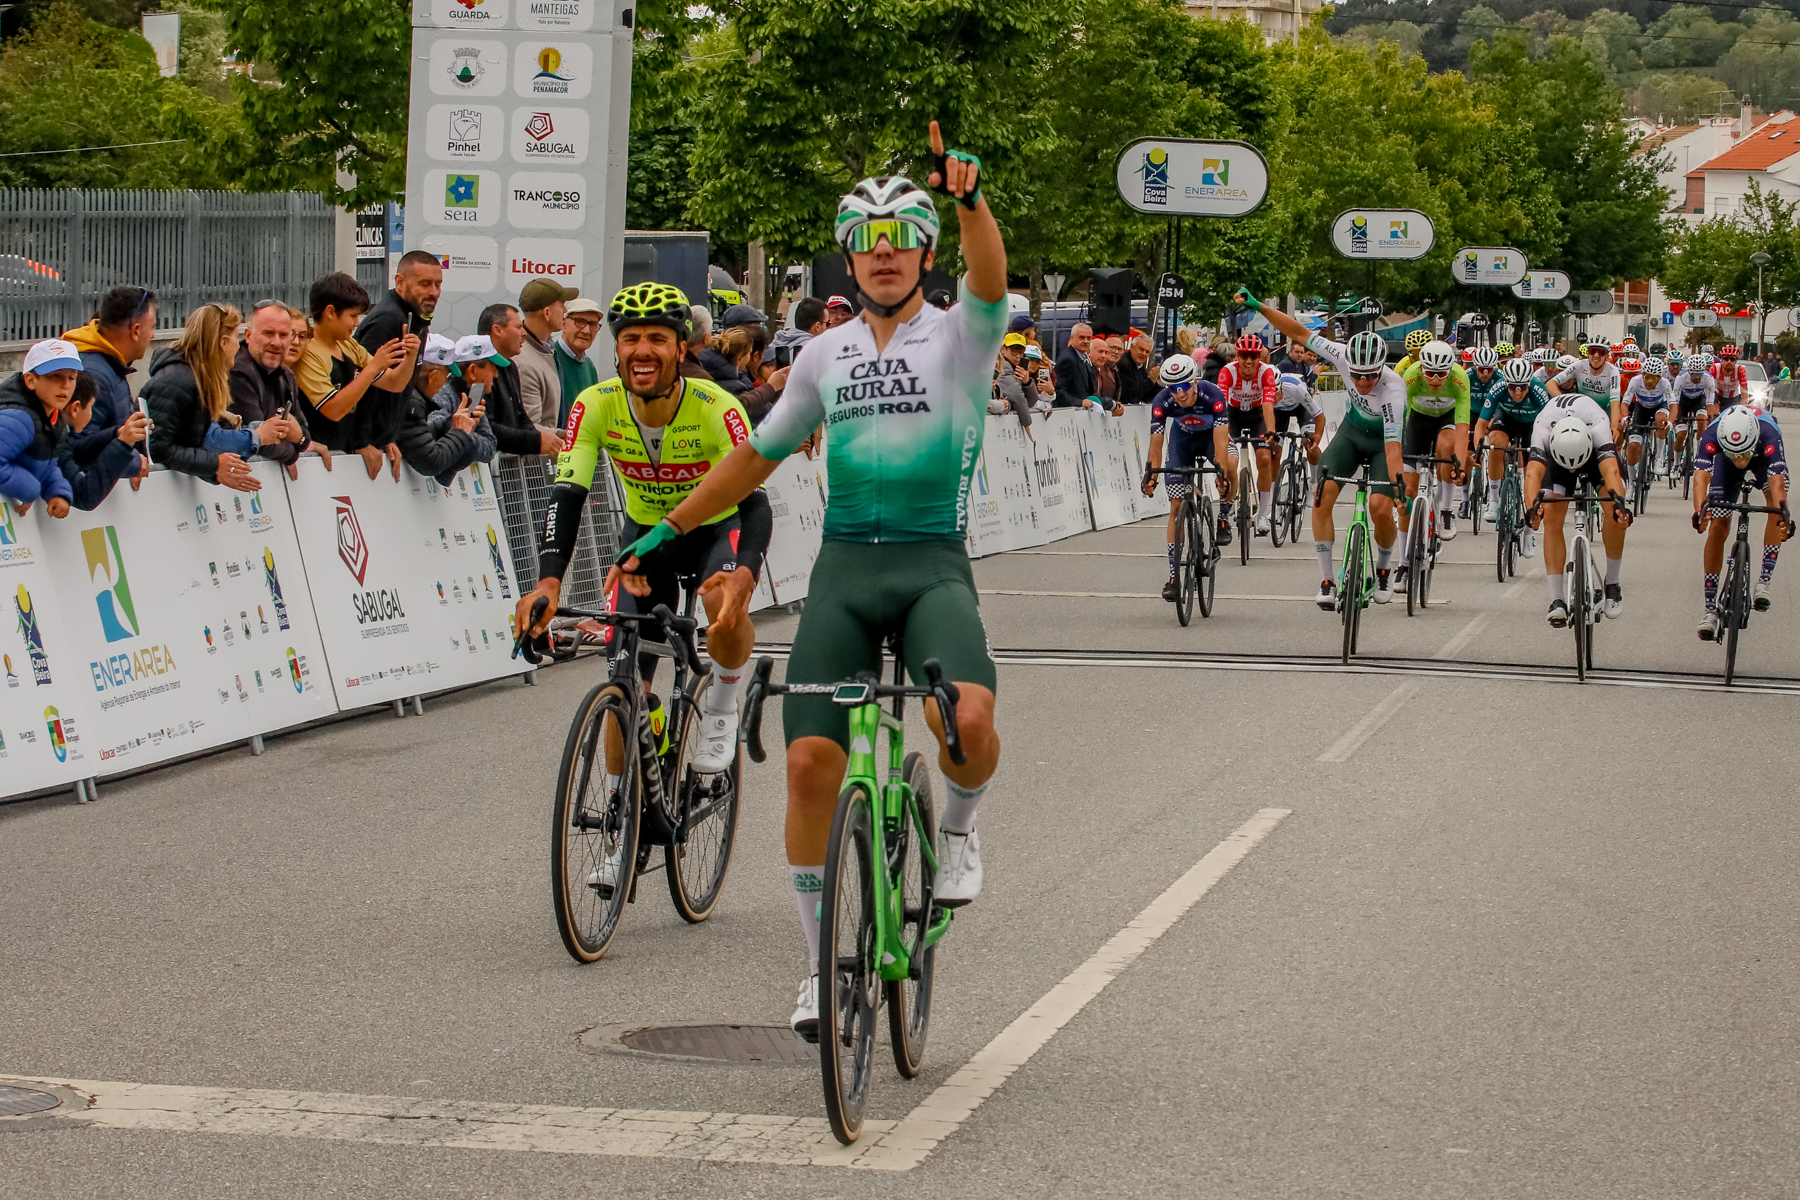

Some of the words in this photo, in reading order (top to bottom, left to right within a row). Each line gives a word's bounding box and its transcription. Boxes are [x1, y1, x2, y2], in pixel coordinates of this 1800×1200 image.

[449, 10, 490, 20] GUARDA
[531, 3, 579, 16] MANTEIGAS
[533, 86, 569, 94] PENAMACOR
[448, 142, 481, 152] Pinhel
[525, 142, 576, 154] SABUGAL
[514, 189, 581, 203] TRANCOSO
[1145, 188, 1166, 196] Cova
[1185, 186, 1248, 197] ENERAREA
[542, 202, 580, 210] MUNICÍPIO
[1144, 195, 1166, 203] Beira
[444, 209, 478, 222] seia
[512, 258, 576, 275] Litocar
[850, 358, 912, 380] CAJA
[835, 377, 927, 405] RURAL
[829, 404, 875, 425] SEGUROS
[878, 401, 931, 414] RGA
[562, 407, 583, 450] SABGAL
[726, 410, 747, 443] SABG
[672, 439, 701, 450] LOVE
[961, 425, 977, 471] CAJA
[614, 460, 705, 480] SABGAL
[955, 474, 970, 532] RURAL
[0, 547, 33, 561] NERAREA
[353, 588, 406, 625] SABUGAL
[90, 644, 177, 692] ENERAREA
[99, 748, 116, 761] Litocar
